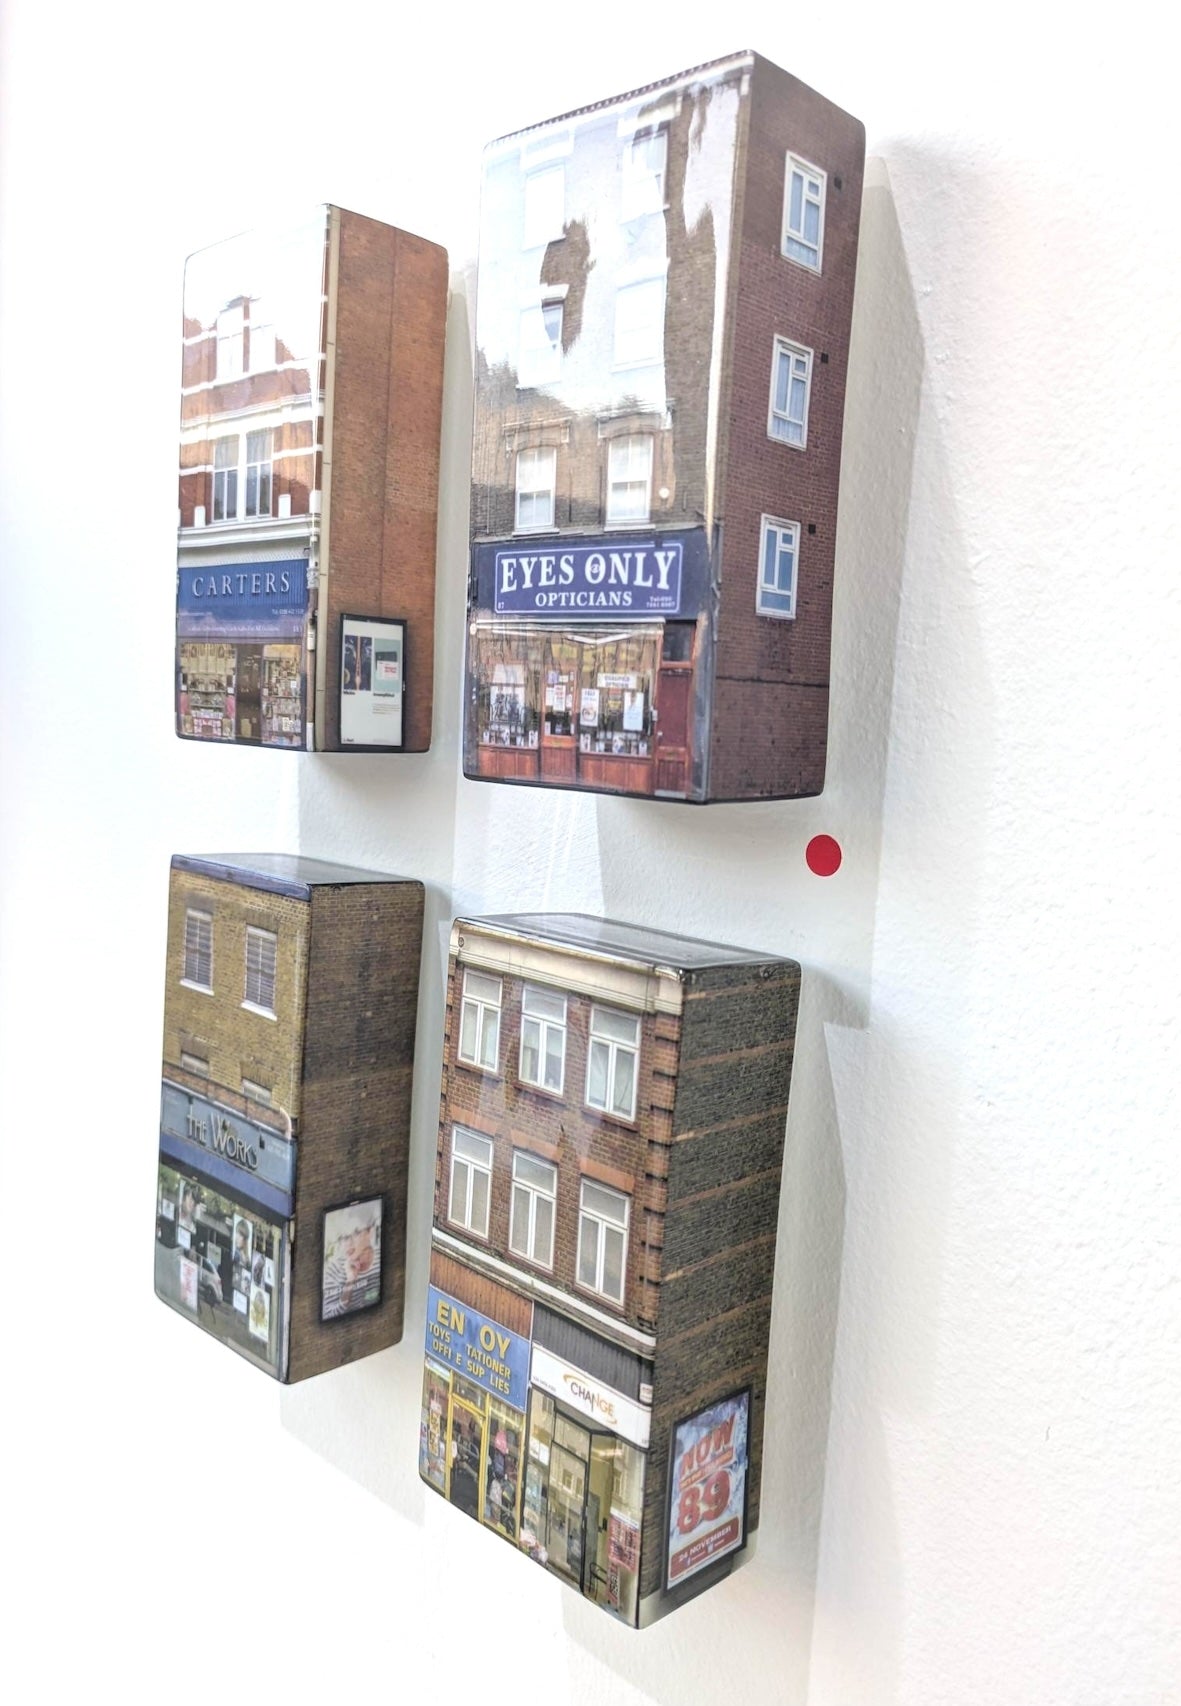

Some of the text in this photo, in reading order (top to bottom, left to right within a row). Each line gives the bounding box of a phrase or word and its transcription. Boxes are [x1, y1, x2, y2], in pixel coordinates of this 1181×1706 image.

[192, 571, 290, 597] CARTERS
[500, 551, 676, 593] EYES ONLY
[535, 591, 632, 607] OPTICIANS
[428, 1322, 451, 1343] TOYS
[570, 1382, 615, 1417] CHANGE
[681, 1412, 736, 1478] NOW
[678, 1470, 732, 1535] 89
[689, 1526, 732, 1556] NOVEMBER
